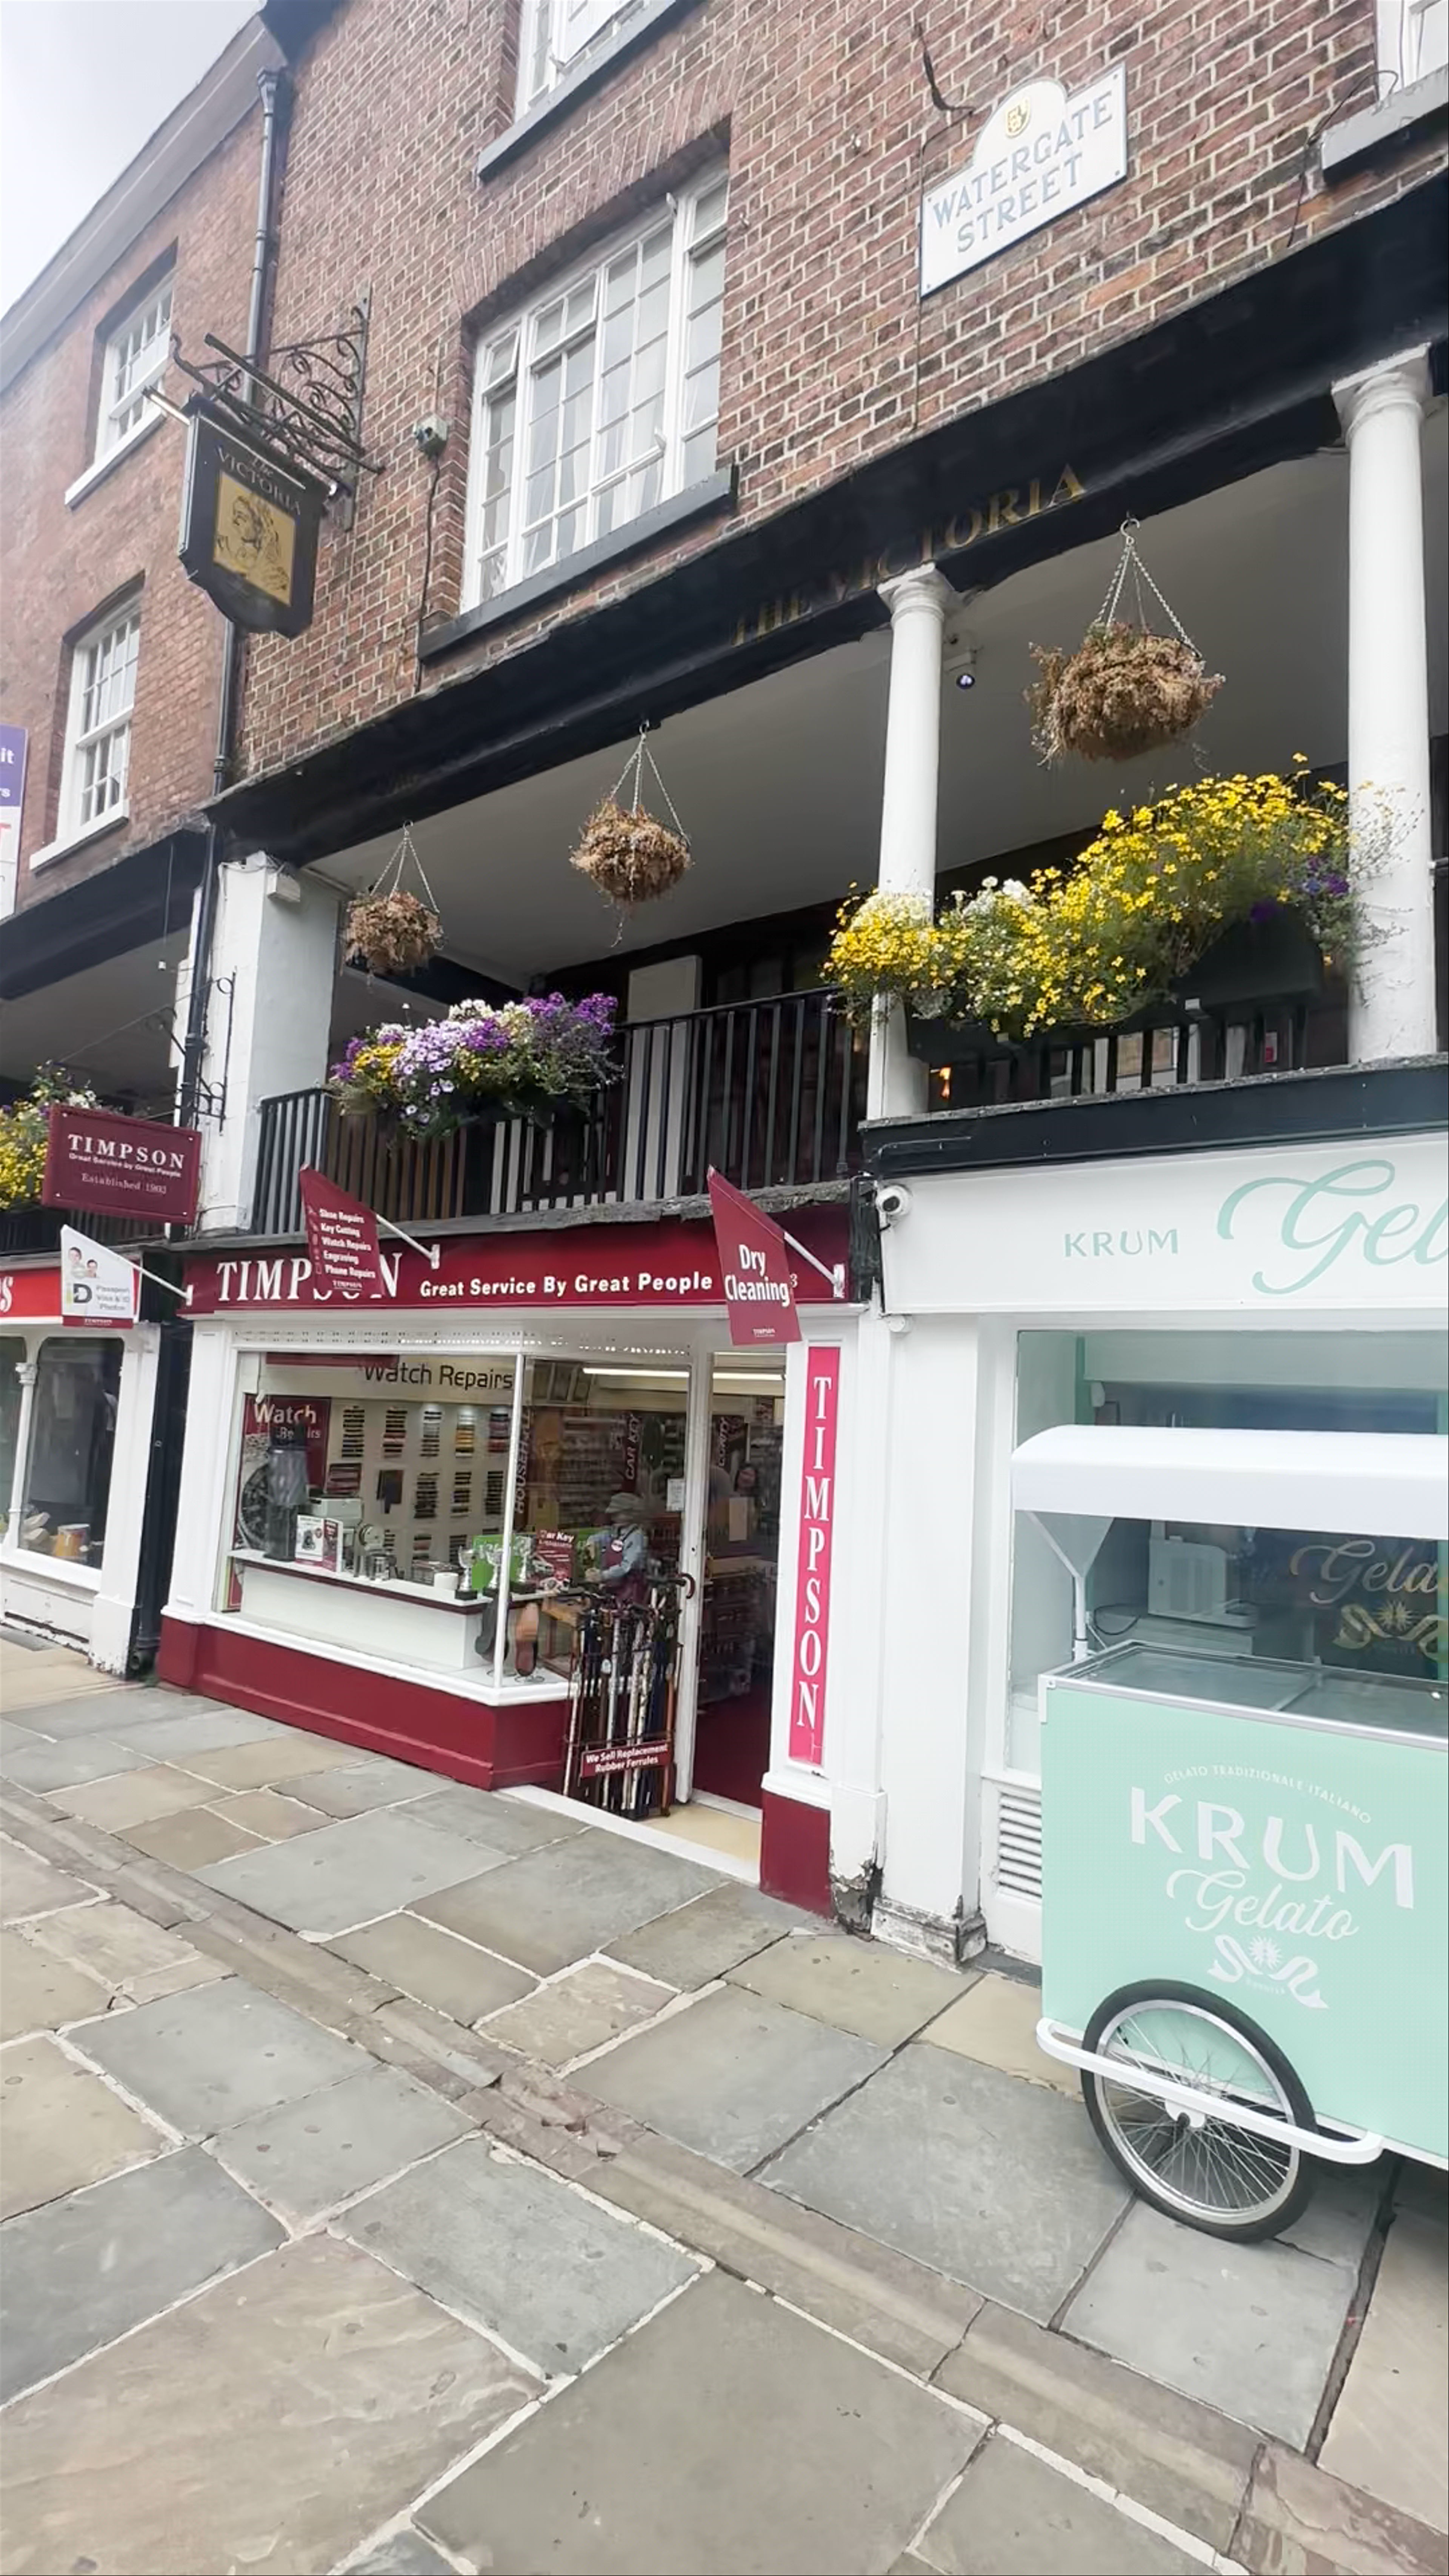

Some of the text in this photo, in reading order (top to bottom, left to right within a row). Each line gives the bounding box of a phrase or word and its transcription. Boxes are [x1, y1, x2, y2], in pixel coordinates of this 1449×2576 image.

[933, 91, 1113, 229] WATERGATE
[957, 152, 1083, 253] STREET
[217, 445, 301, 516] VICTORIA
[68, 1134, 185, 1169] TIMPSON
[319, 1208, 365, 1223] Shoe Repairs
[321, 1223, 360, 1238] Key Cutting
[321, 1236, 372, 1251] Watch Repairs
[323, 1250, 359, 1265] Engraving
[1064, 1229, 1178, 1257] KRUM
[325, 1264, 376, 1279] Phone Repairs
[738, 1244, 766, 1275] Dry
[216, 1251, 713, 1301] TIMPN Great Service By Great People
[724, 1275, 790, 1307] Cleaning
[365, 1362, 513, 1391] Watch Repairs
[254, 1402, 317, 1425] Watch
[796, 1376, 832, 1729] TIMPSON
[586, 1744, 668, 1764] We Sell Replacement
[595, 1756, 658, 1773] Rubber Ferrules
[1163, 1764, 1371, 1824] GELATO TRADIZIONALE ITALIANO
[1131, 1787, 1414, 1910] KRUM
[1166, 1869, 1359, 1940] Gelato
